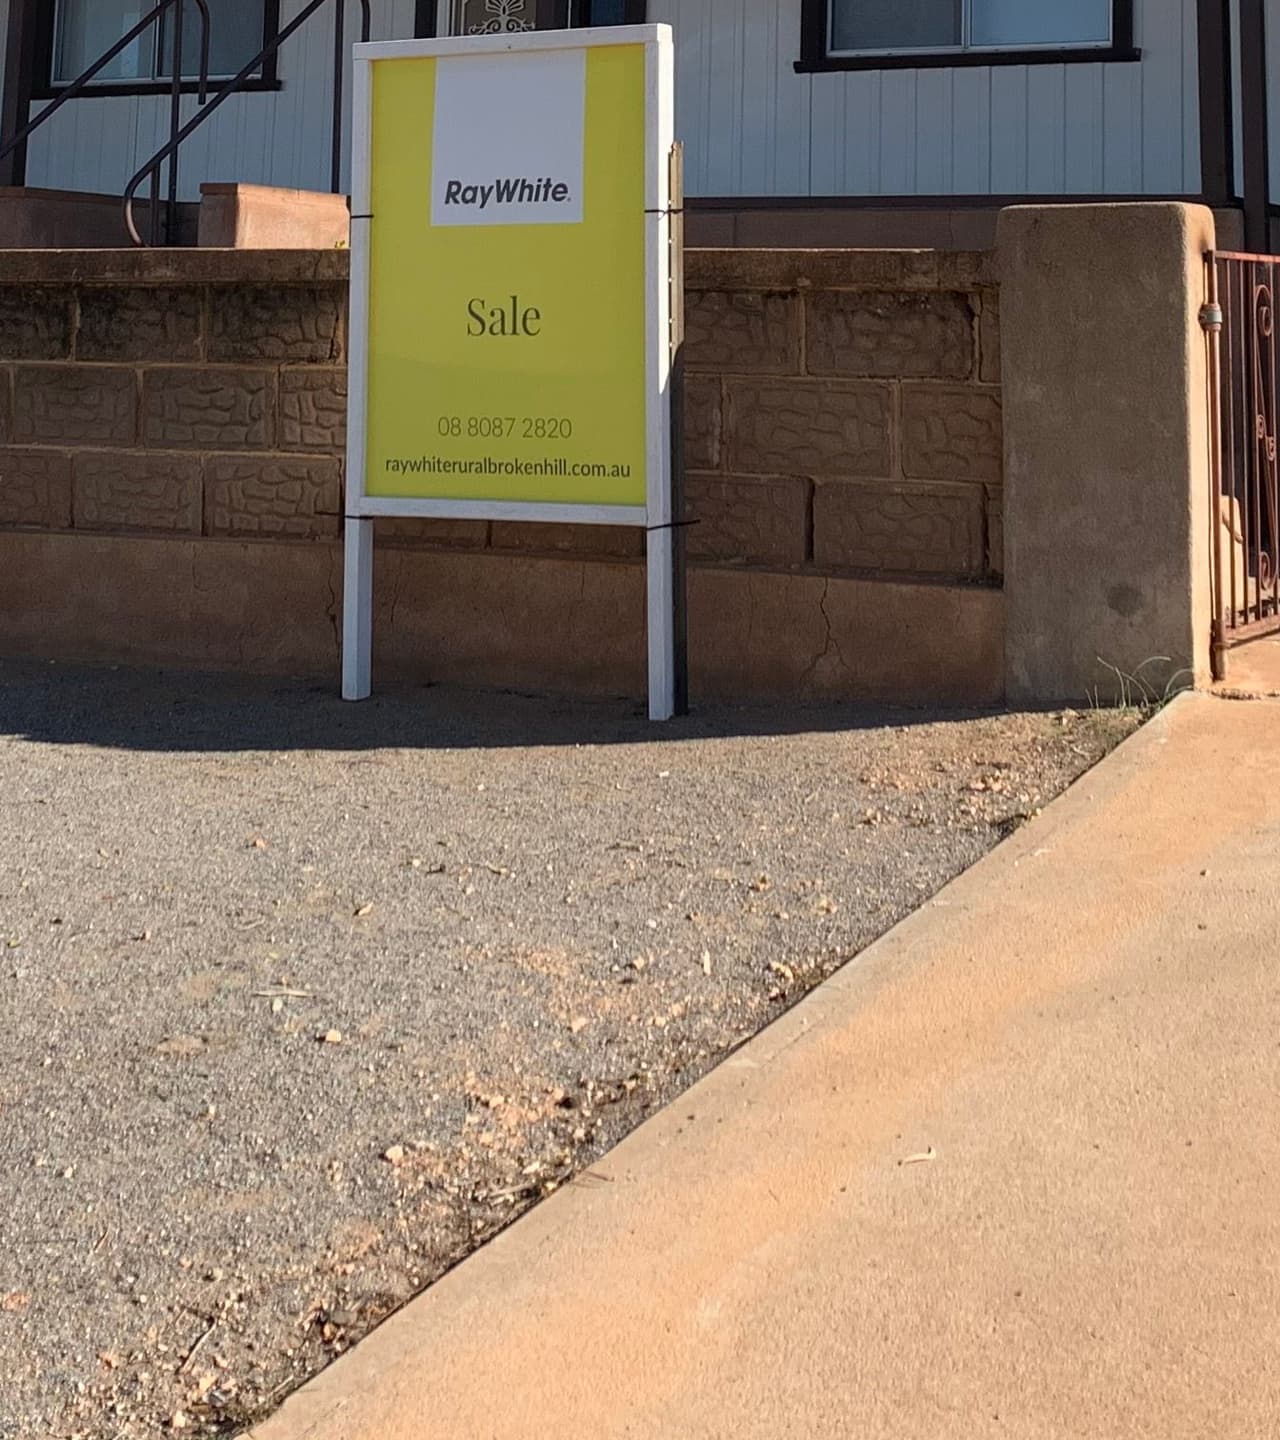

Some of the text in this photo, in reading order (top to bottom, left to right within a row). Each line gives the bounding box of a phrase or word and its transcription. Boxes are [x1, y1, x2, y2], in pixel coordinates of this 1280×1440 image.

[466, 295, 541, 337] Sale
[438, 416, 572, 439] 08 8087 2820
[385, 456, 631, 478] raywhiteruralbrokenhill.com.au
